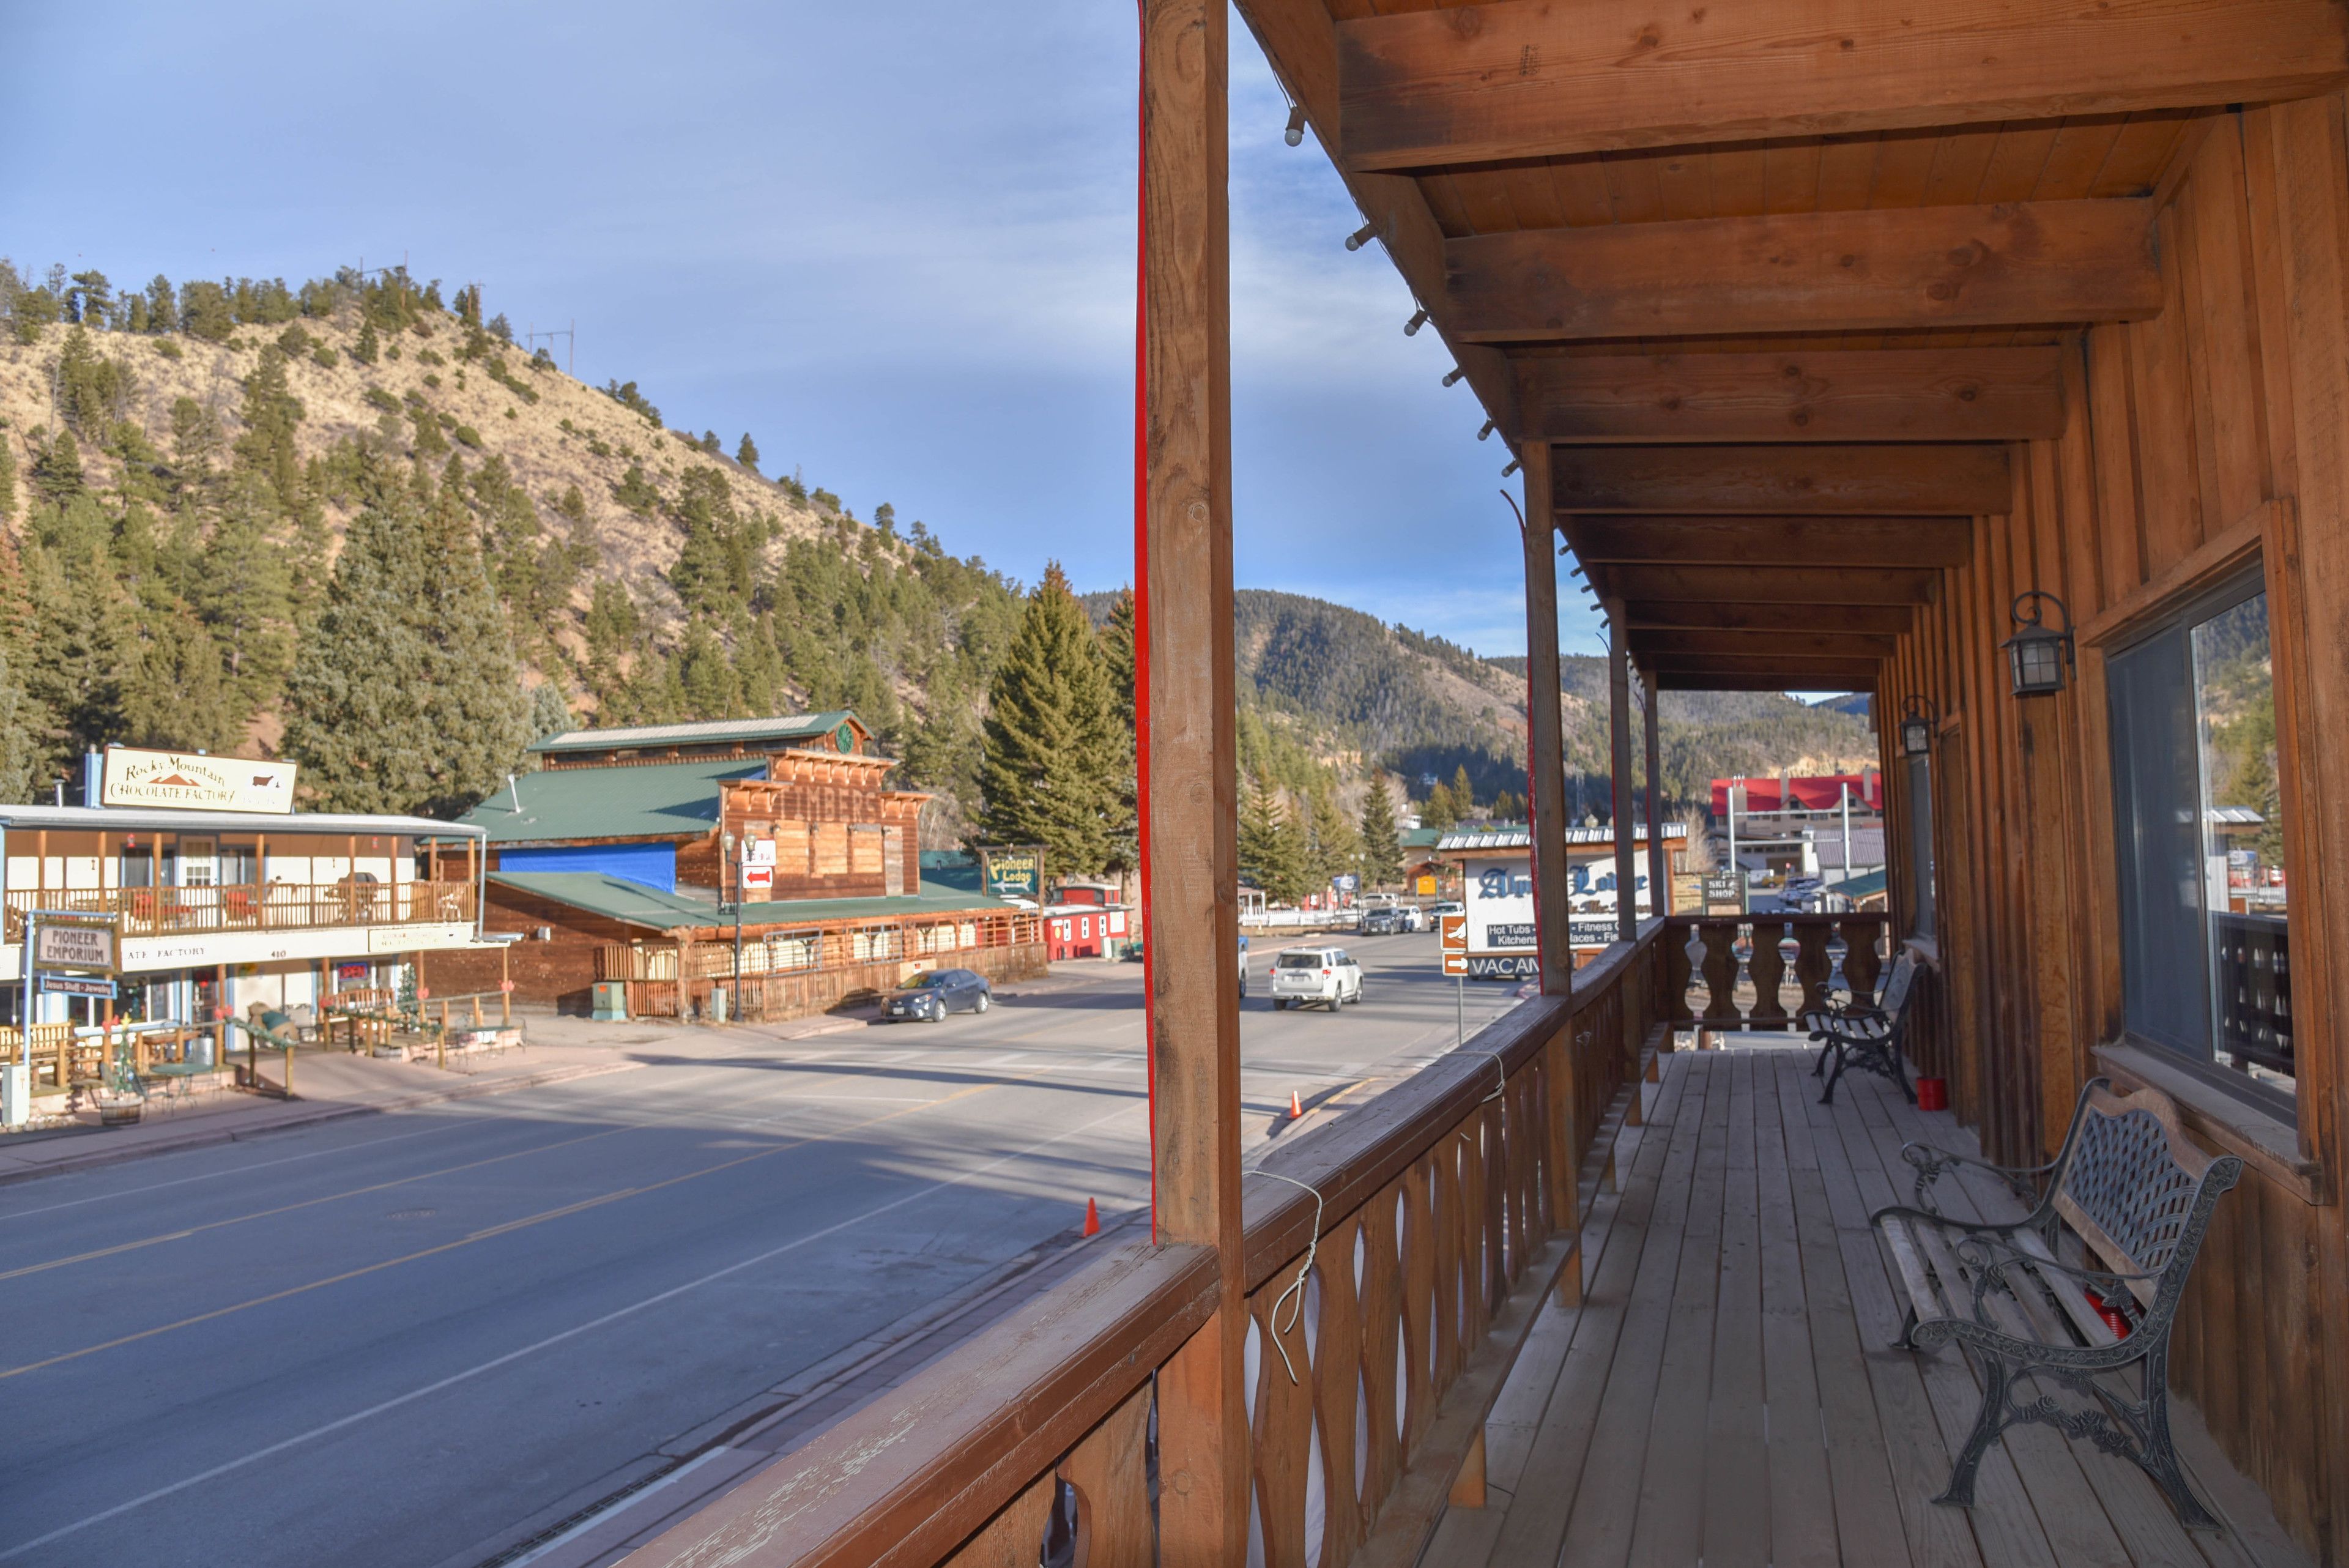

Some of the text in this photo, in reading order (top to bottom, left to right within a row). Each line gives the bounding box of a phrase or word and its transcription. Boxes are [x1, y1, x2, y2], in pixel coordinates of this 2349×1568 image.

[126, 754, 225, 787] Rocky Mountain
[110, 782, 181, 798] CHOCOLATE
[185, 789, 236, 803] FACTORY
[1003, 870, 1031, 886] Lodge
[1478, 864, 1648, 899] Alp Lode
[1709, 880, 1726, 889] SKI
[1709, 889, 1735, 897] SHOP
[1488, 926, 1505, 935] Hot
[1507, 924, 1531, 934] Tubs
[1578, 922, 1612, 932] Fitness
[52, 930, 98, 946] PIONEER
[1497, 935, 1537, 945] Kitchens
[1604, 932, 1619, 942] Fis
[46, 947, 104, 962] EMPORIUM
[157, 947, 206, 958] FACTORY
[271, 950, 286, 959] 410
[338, 965, 365, 979] OPEN
[1471, 957, 1540, 975] VACAN
[45, 980, 64, 990] Jesus
[64, 982, 80, 992] Stuff
[85, 983, 111, 995] Jewelry
